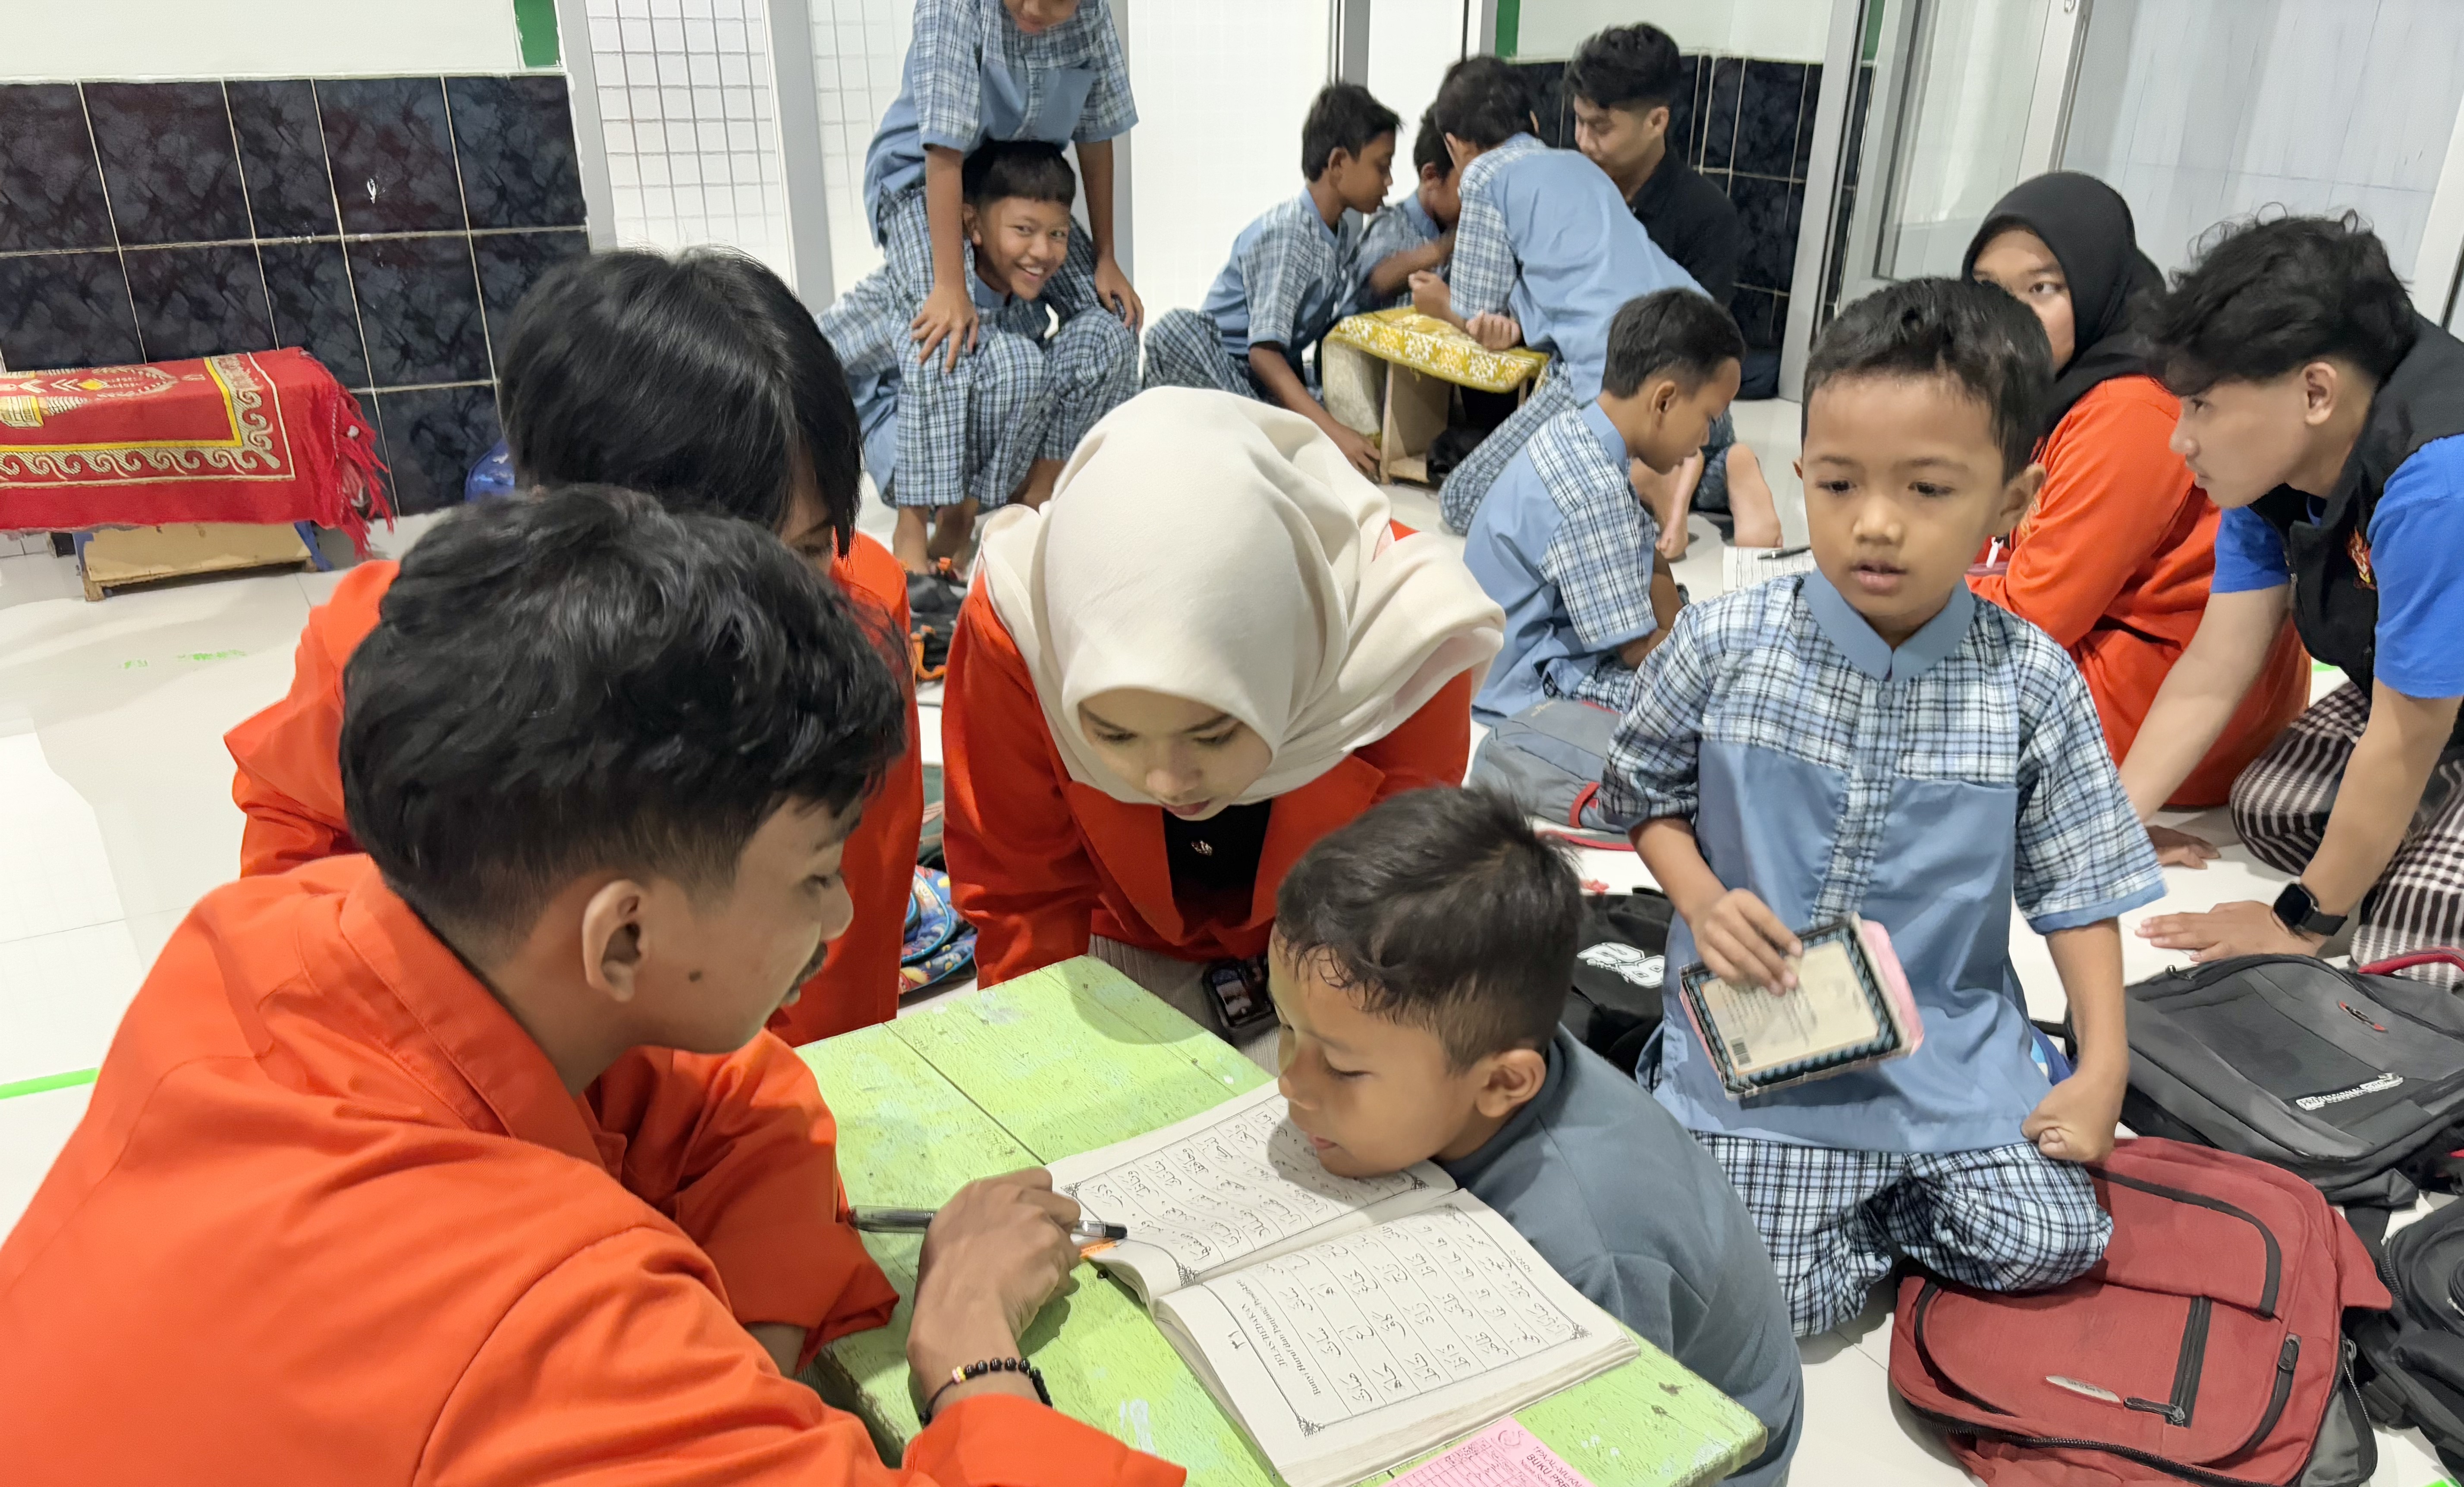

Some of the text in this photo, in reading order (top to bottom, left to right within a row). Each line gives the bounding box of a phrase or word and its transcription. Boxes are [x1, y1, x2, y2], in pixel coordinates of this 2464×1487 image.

[1279, 1334, 1291, 1348] dan
[1265, 1340, 1288, 1366] JELAS
[1285, 1349, 1306, 1371] Huruf
[1304, 1372, 1321, 1396] Bunyi
[1526, 1453, 1553, 1475] BUKU
